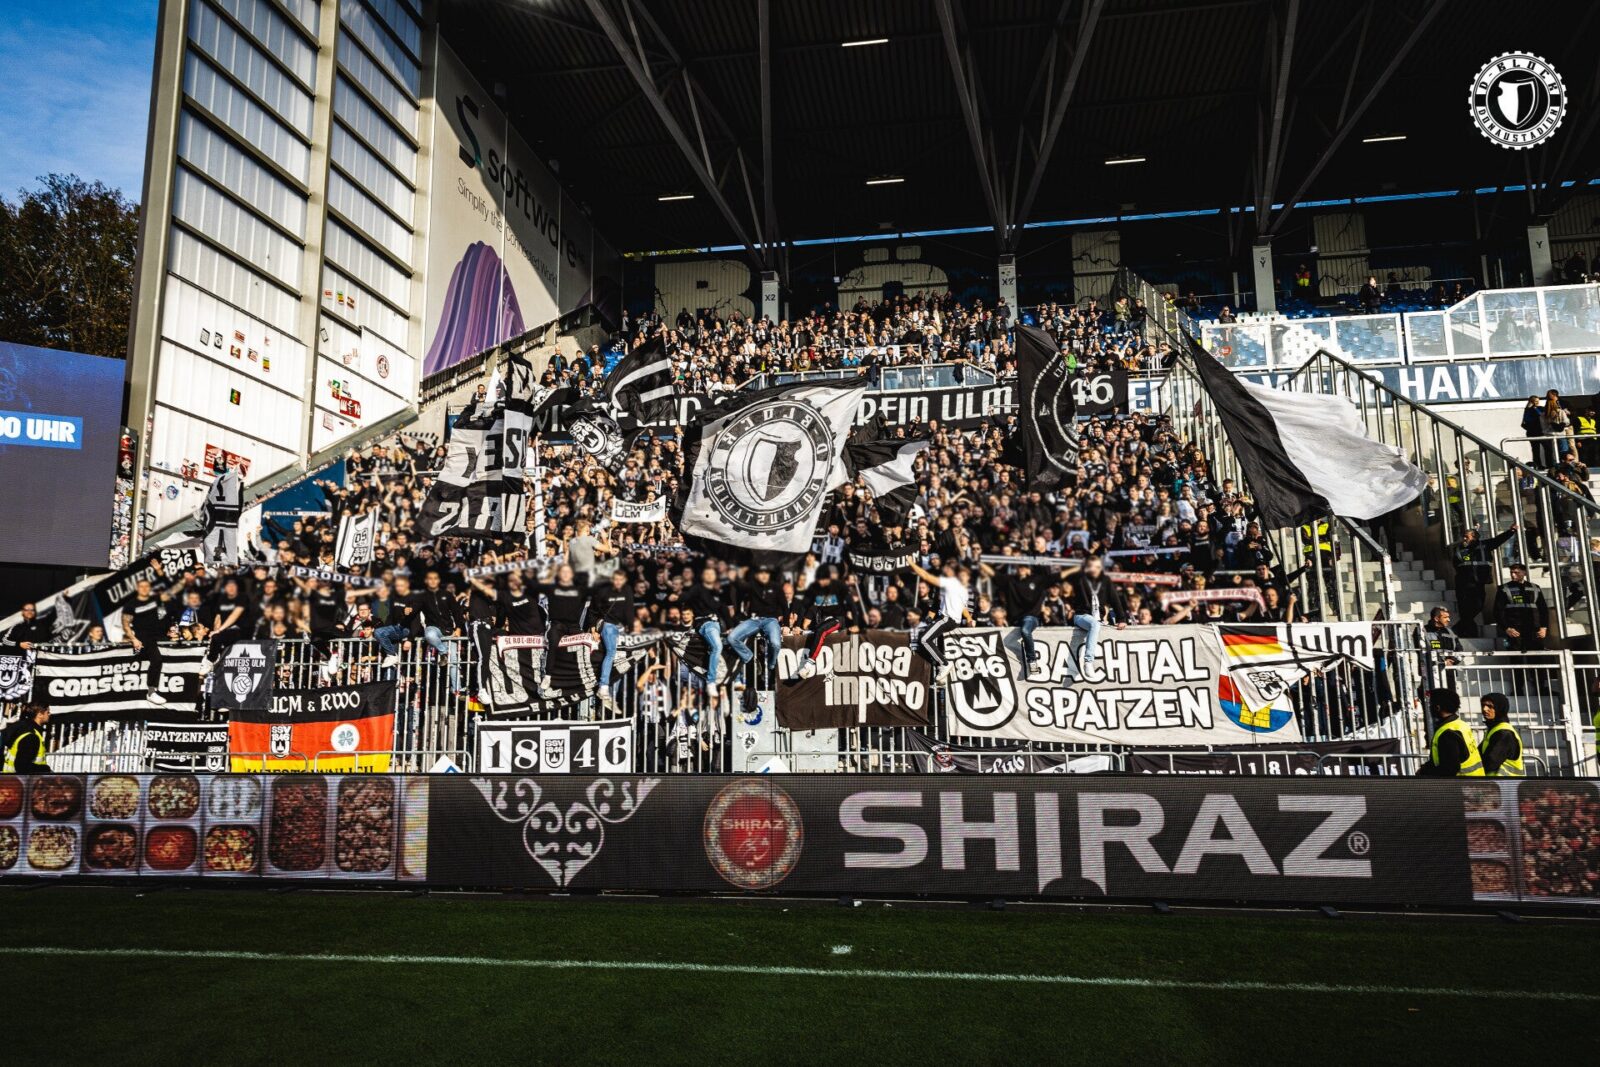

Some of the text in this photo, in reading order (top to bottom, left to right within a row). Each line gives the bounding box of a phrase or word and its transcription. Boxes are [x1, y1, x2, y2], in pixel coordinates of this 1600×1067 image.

[458, 177, 489, 222] Simplify
[490, 211, 503, 233] the
[764, 293, 776, 302] X2
[1399, 363, 1501, 401] HAIX
[941, 386, 1013, 421] ULM
[0, 416, 76, 443] 0 UHR
[944, 634, 999, 660] SSV
[1300, 627, 1367, 657] ulm
[102, 661, 140, 675] nero
[251, 659, 266, 668] ULM
[949, 656, 1007, 682] 1846
[307, 700, 316, 712] &
[321, 690, 361, 711] RWO
[824, 676, 925, 723] impero
[1025, 687, 1214, 730] SPATZEN
[147, 730, 228, 742] SPATZENFANS
[271, 726, 291, 734] SSV
[271, 733, 290, 741] 1846
[722, 818, 785, 832] SHIRAZ
[840, 791, 1372, 895] SHIRAZ
